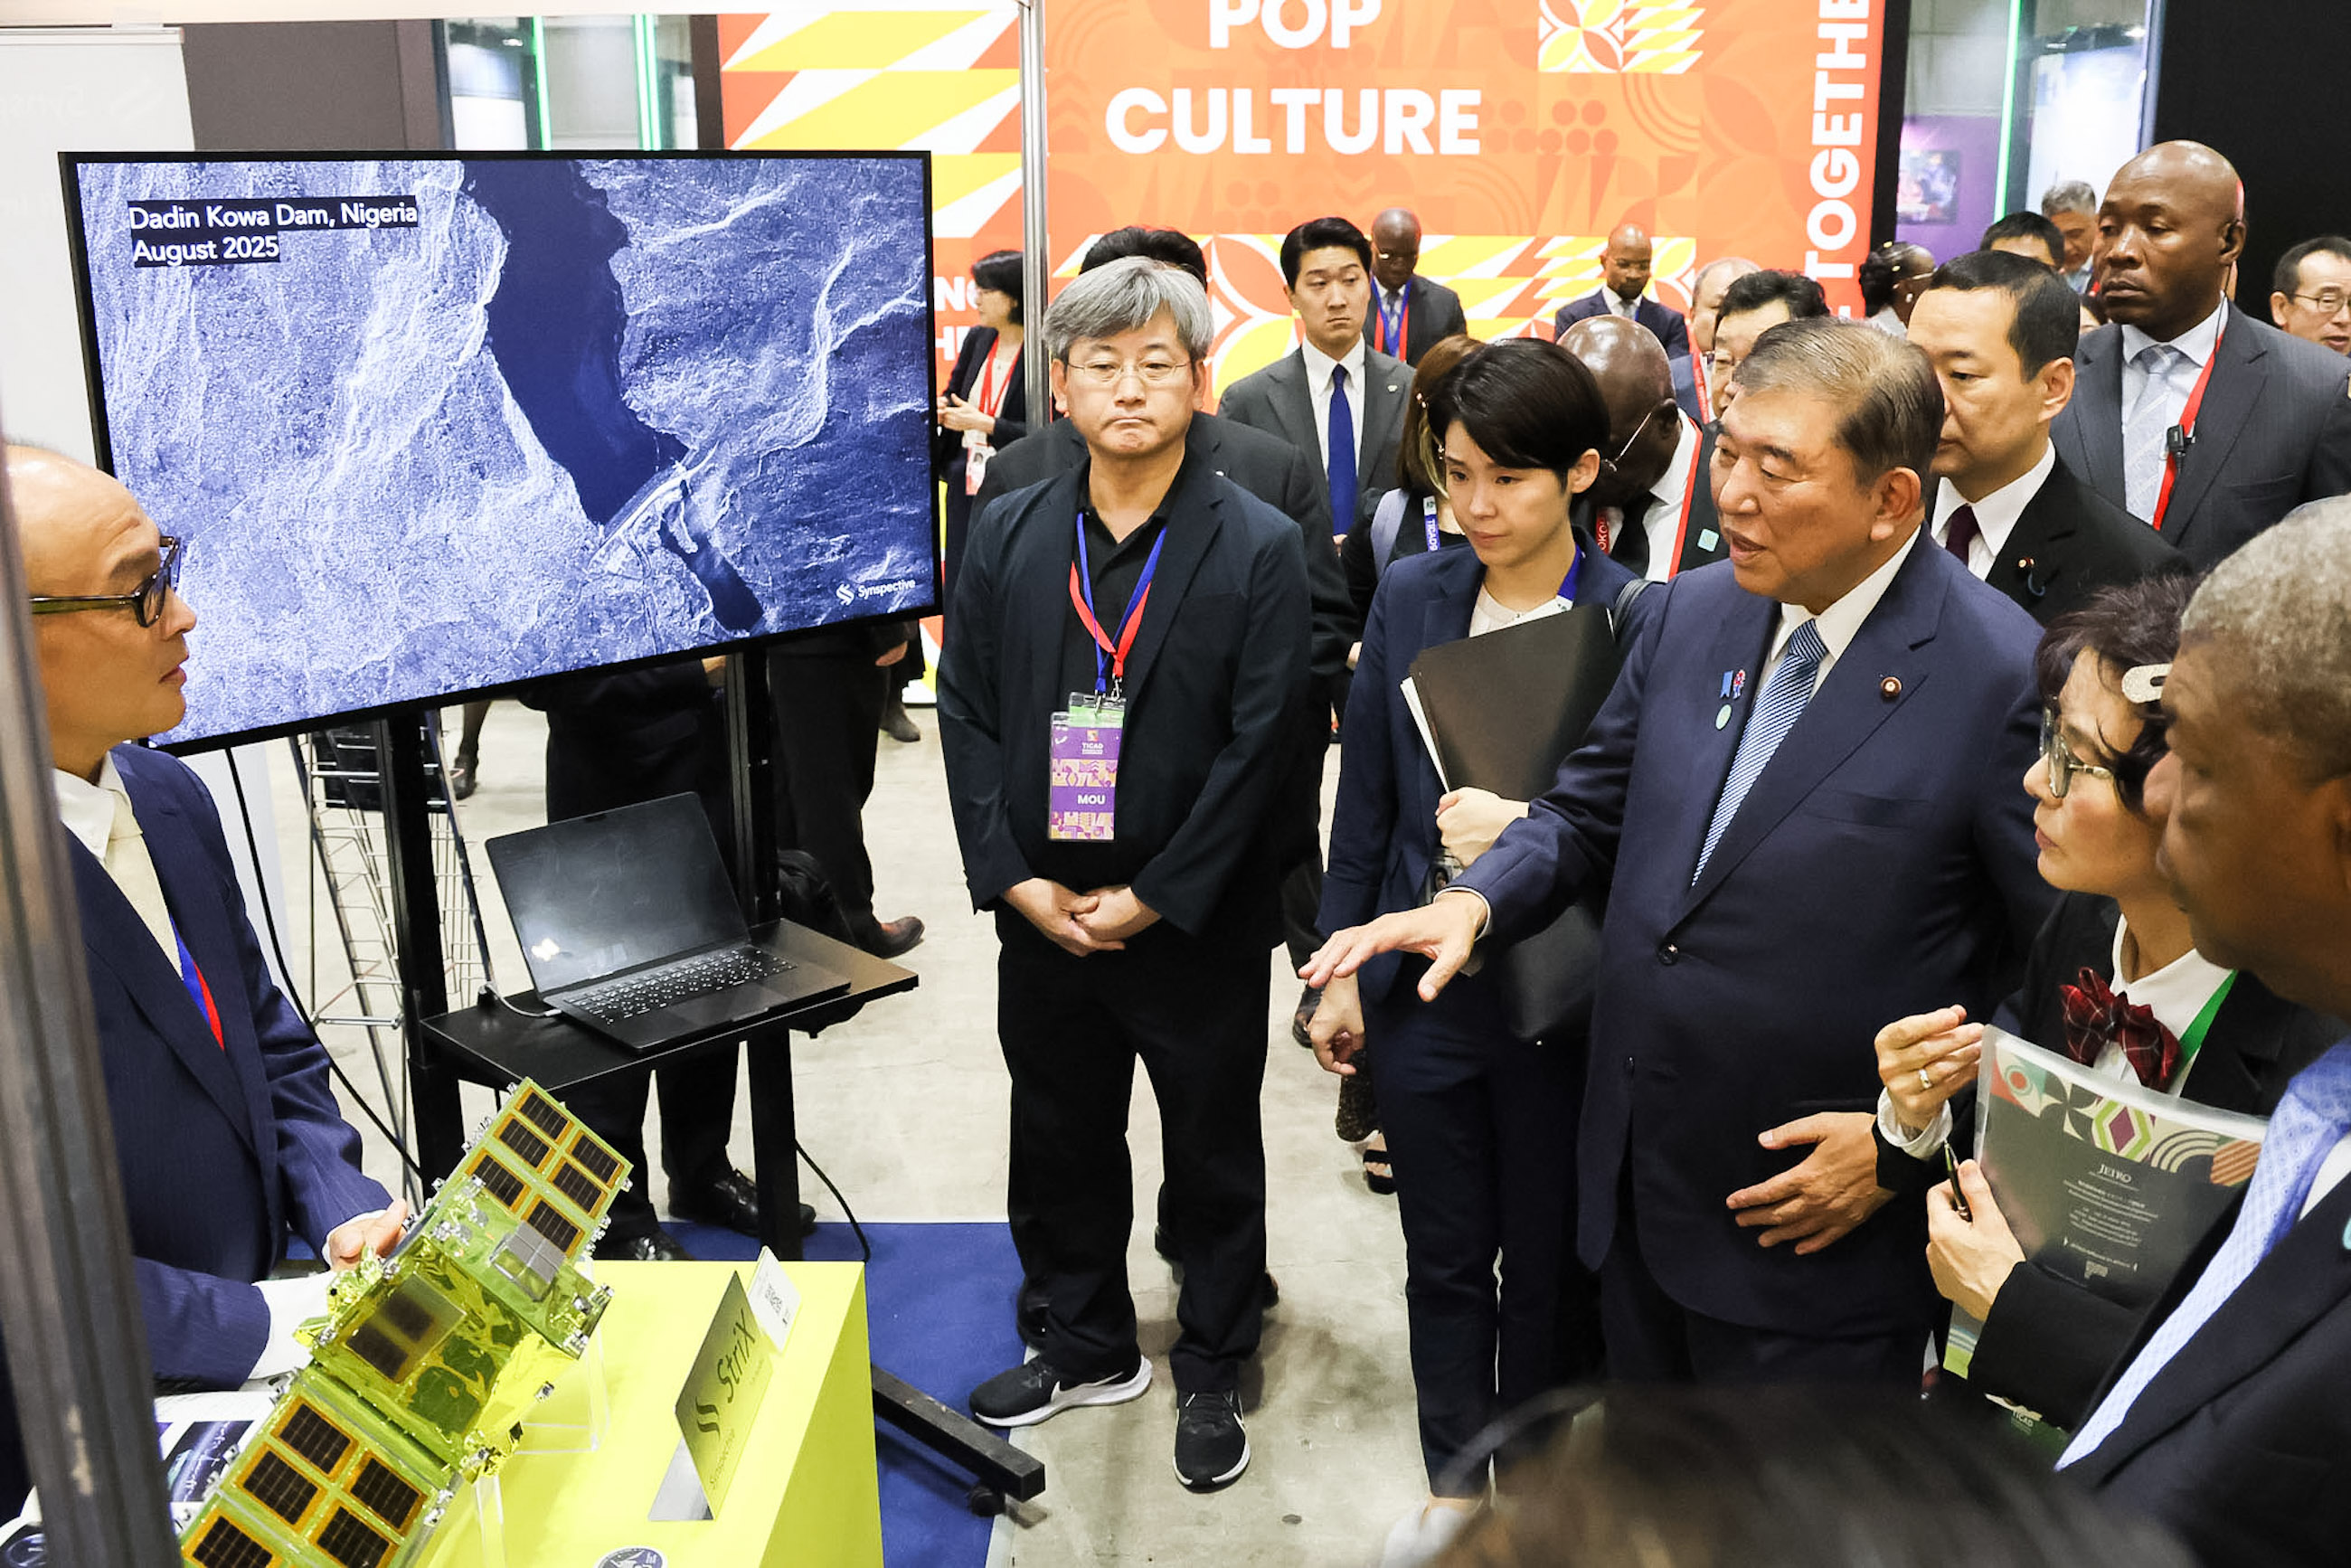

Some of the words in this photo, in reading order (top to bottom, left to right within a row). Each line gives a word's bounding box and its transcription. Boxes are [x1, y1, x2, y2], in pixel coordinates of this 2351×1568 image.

[1209, 0, 1382, 49] POP
[1105, 88, 1481, 155] CULTURE
[128, 205, 199, 230] Dadin
[205, 205, 270, 228] Kowa
[275, 203, 335, 228] Dam,
[340, 202, 418, 228] Nigeria
[133, 239, 218, 265] August
[222, 235, 279, 260] 2025
[858, 580, 916, 600] Synspective
[1077, 794, 1106, 805] MOU
[717, 1308, 756, 1403] StriX
